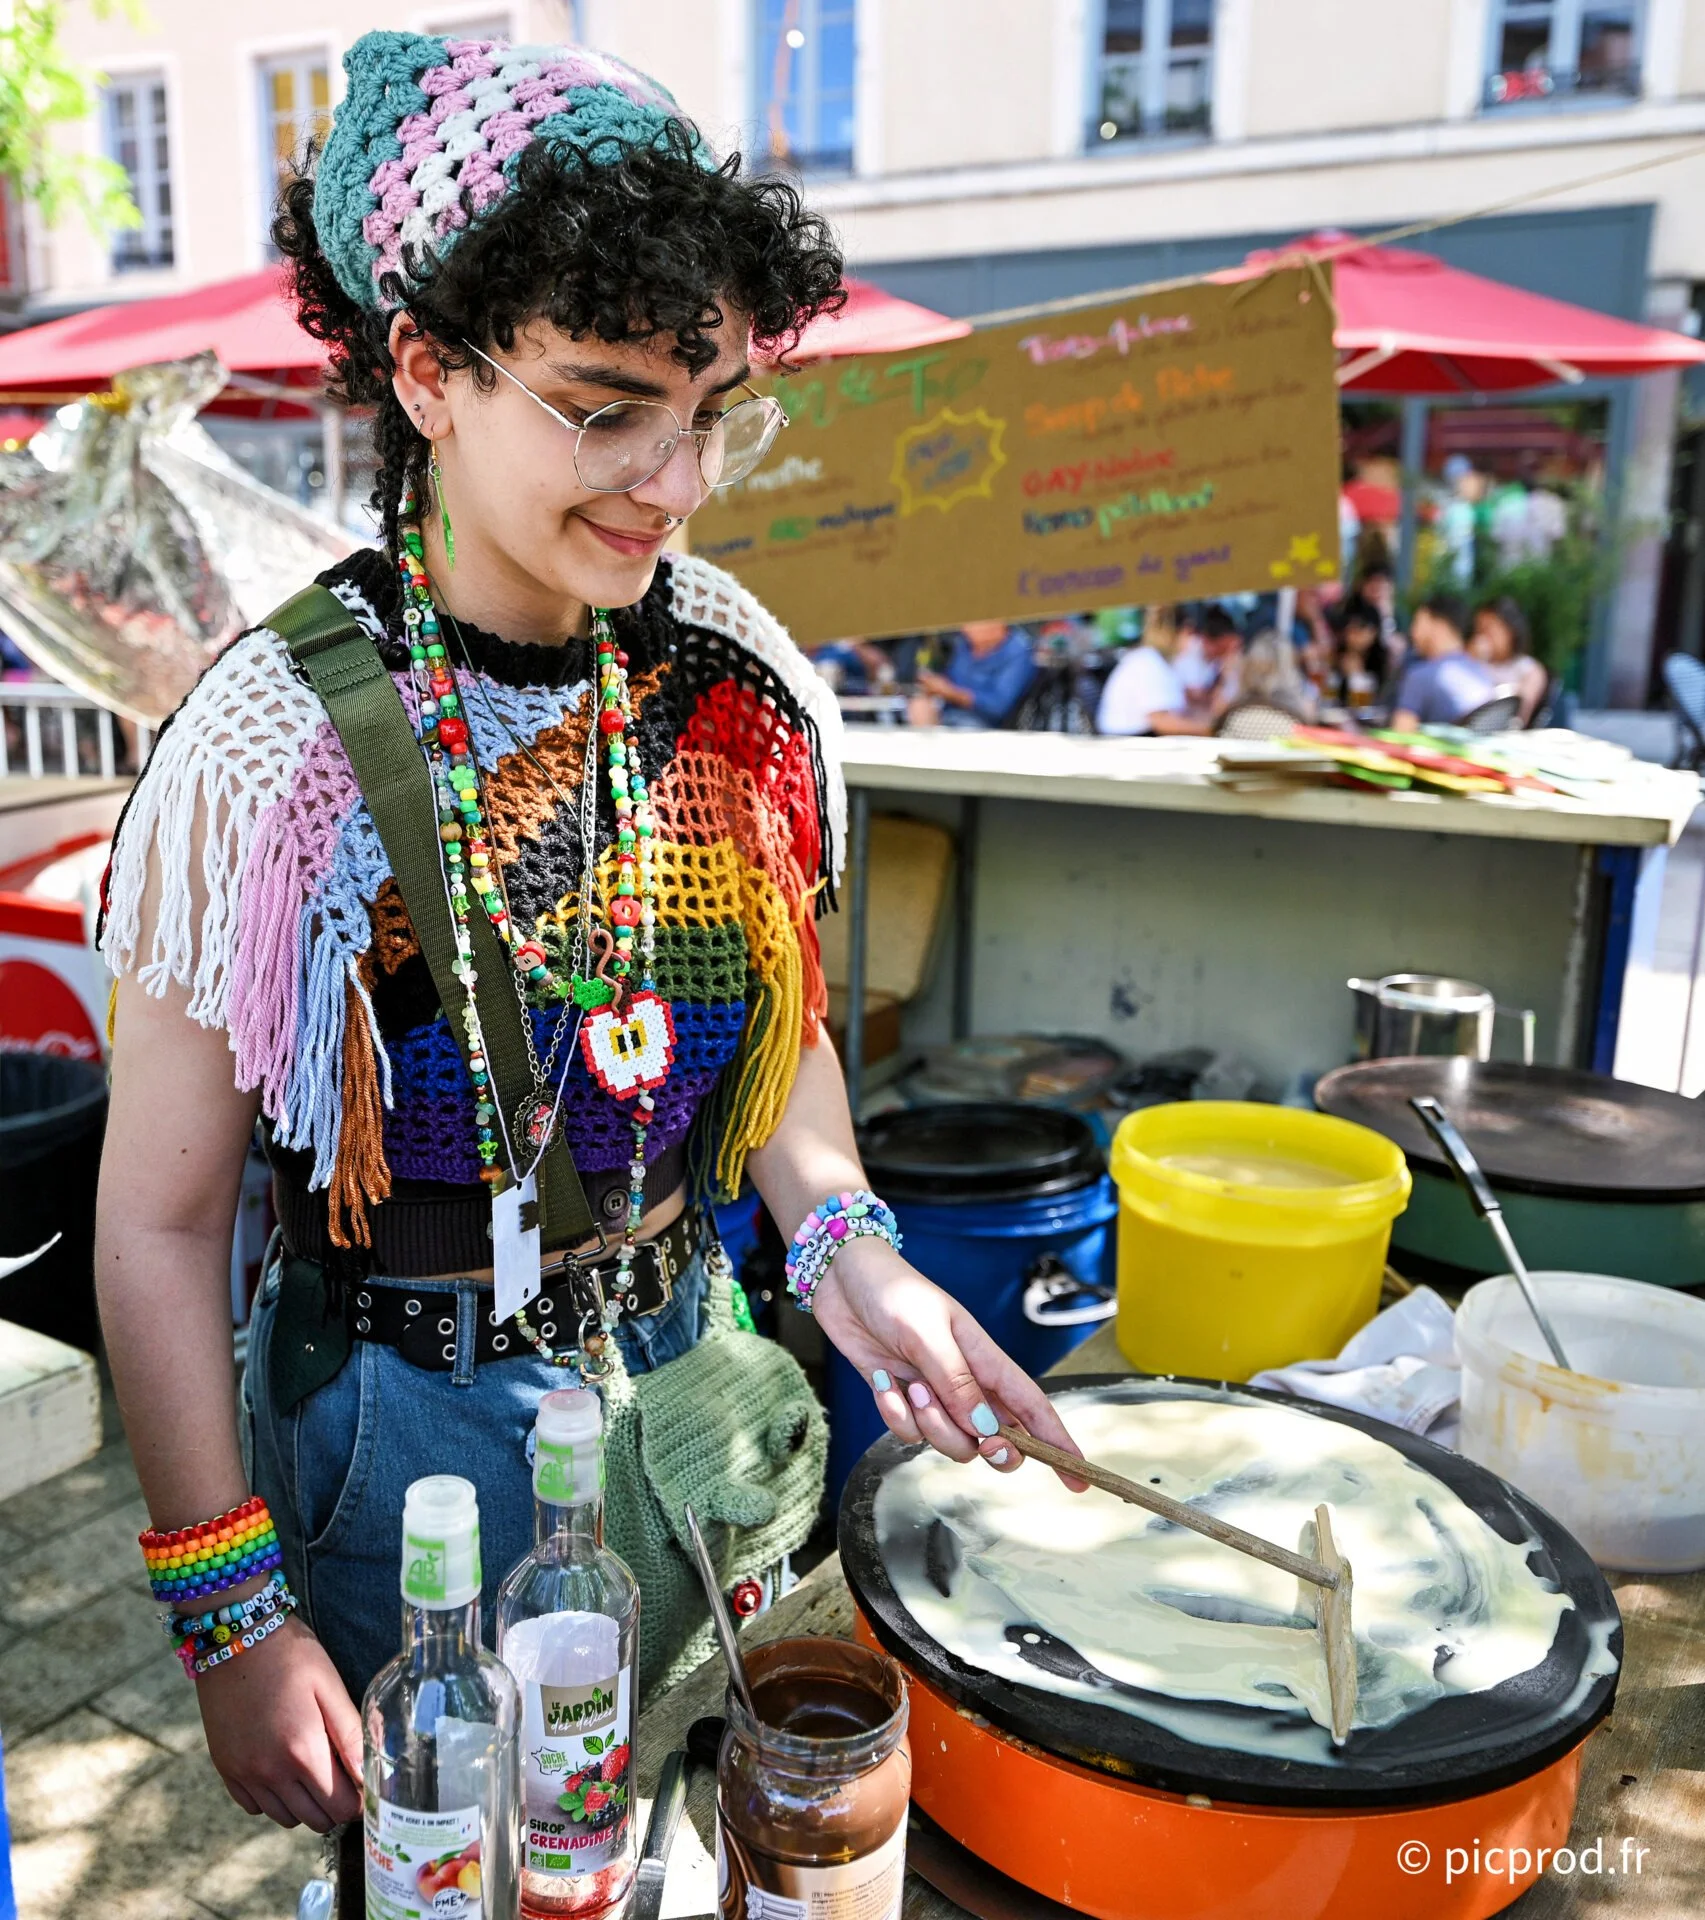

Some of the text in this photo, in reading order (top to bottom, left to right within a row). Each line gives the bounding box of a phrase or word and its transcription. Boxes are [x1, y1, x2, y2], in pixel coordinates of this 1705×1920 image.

[407, 1558, 437, 1584] AB
[551, 1701, 561, 1710] LE
[550, 1717, 572, 1734] des
[540, 1751, 567, 1765] SUCRE
